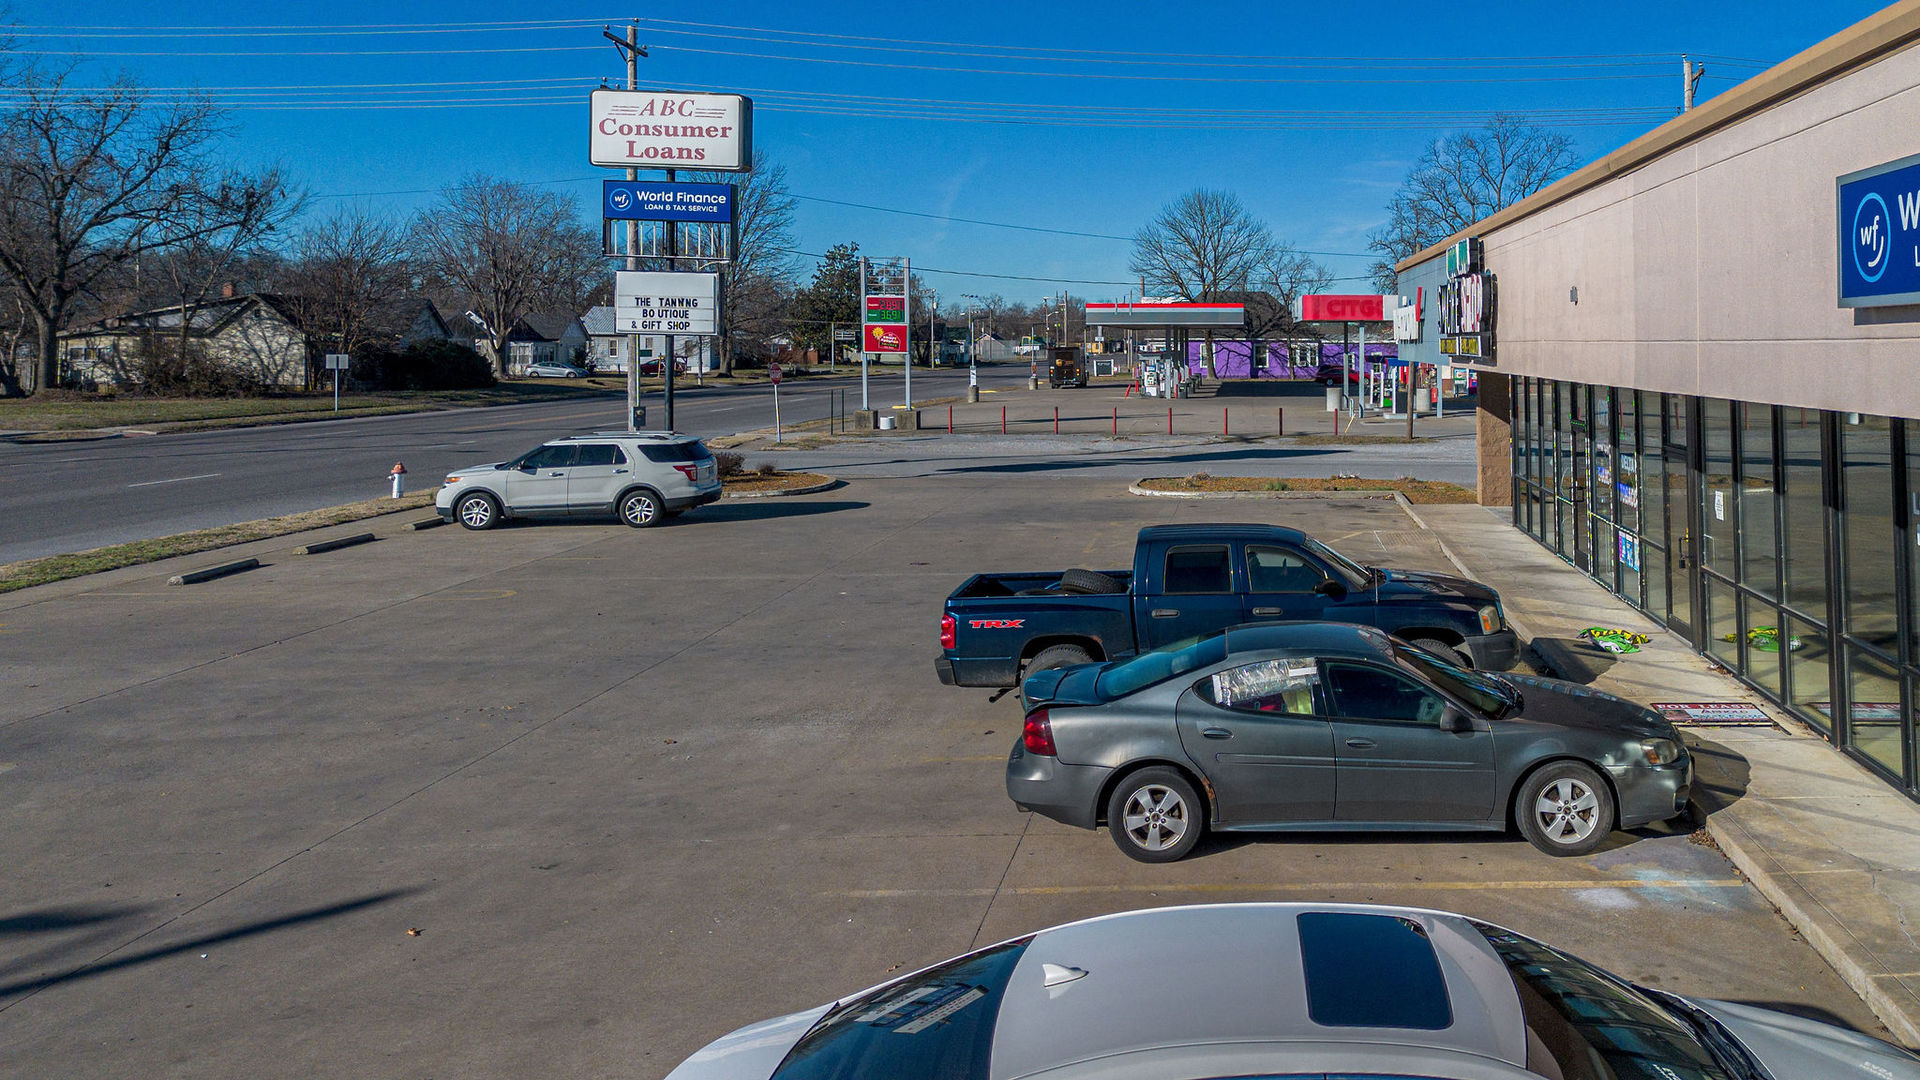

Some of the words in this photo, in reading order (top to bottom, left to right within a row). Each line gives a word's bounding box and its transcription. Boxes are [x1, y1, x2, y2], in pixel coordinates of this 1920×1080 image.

[639, 98, 695, 117] ABC
[598, 118, 732, 138] Consumer
[626, 140, 705, 161] Loans
[636, 190, 674, 202] World
[676, 192, 727, 204] Finance
[644, 203, 664, 211] LOAN
[673, 204, 687, 212] TAX
[688, 205, 718, 213] SERVICE
[635, 297, 651, 307] THE
[1327, 299, 1383, 318] CITG
[631, 320, 638, 329] &
[641, 320, 662, 330] GIFT
[667, 321, 691, 331] SHOP
[969, 619, 1025, 629] TRX
